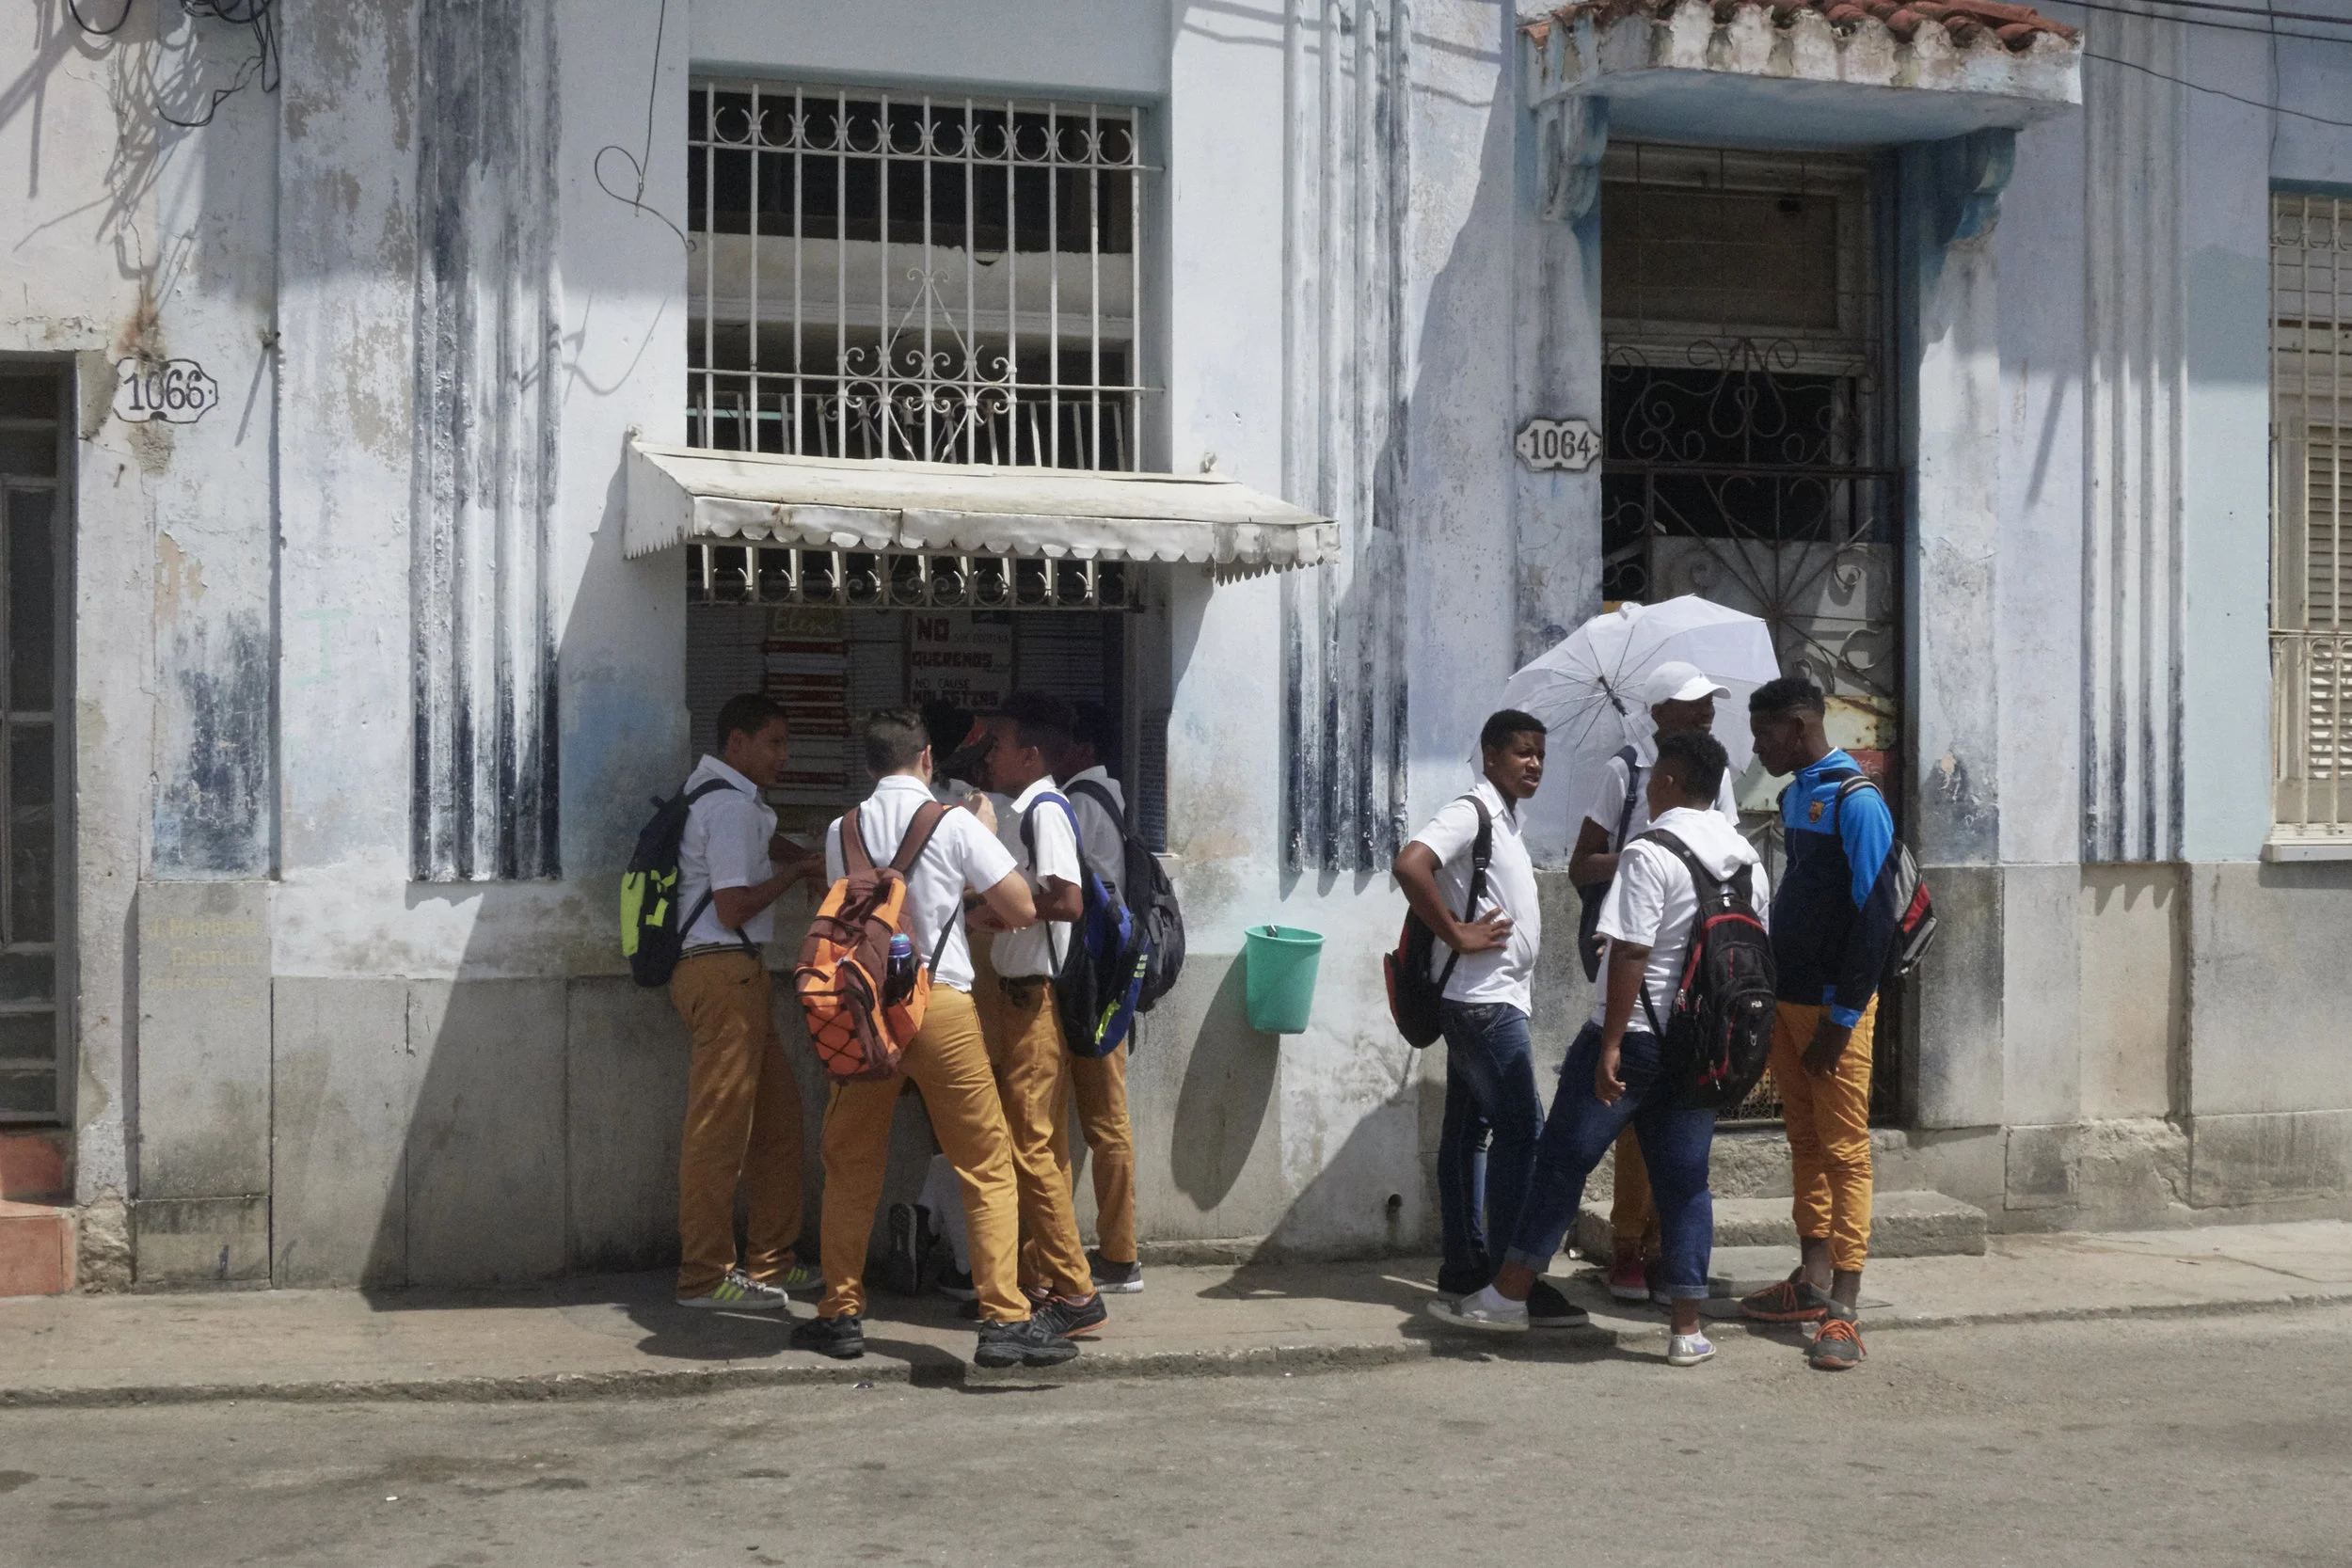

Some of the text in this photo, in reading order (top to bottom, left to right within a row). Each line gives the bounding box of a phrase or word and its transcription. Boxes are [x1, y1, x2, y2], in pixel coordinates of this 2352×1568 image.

[123, 369, 205, 411] 1066
[1530, 429, 1590, 461] 1064
[916, 617, 949, 641] NO
[912, 651, 993, 669] QUEREMOS
[915, 677, 971, 689] NO CAUSE
